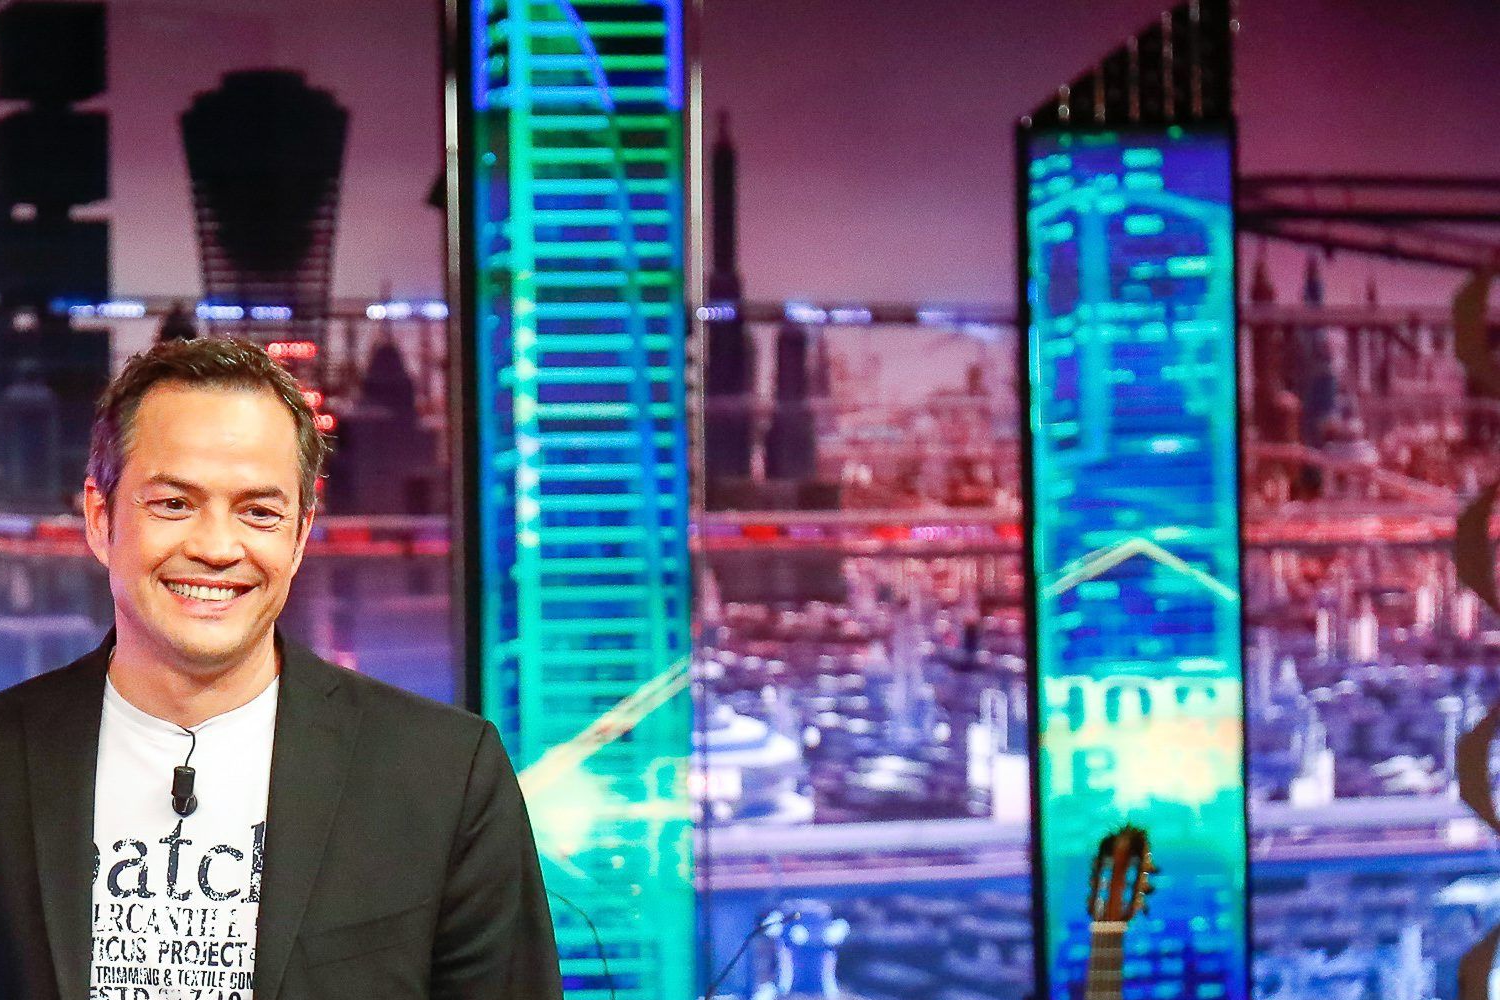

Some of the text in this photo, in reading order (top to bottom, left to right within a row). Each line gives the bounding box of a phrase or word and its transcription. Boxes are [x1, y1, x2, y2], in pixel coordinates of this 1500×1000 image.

[158, 940, 248, 967] PROJECT
[95, 966, 160, 986] TRIMMING
[164, 969, 173, 986] &
[178, 970, 226, 989] TEXTILE
